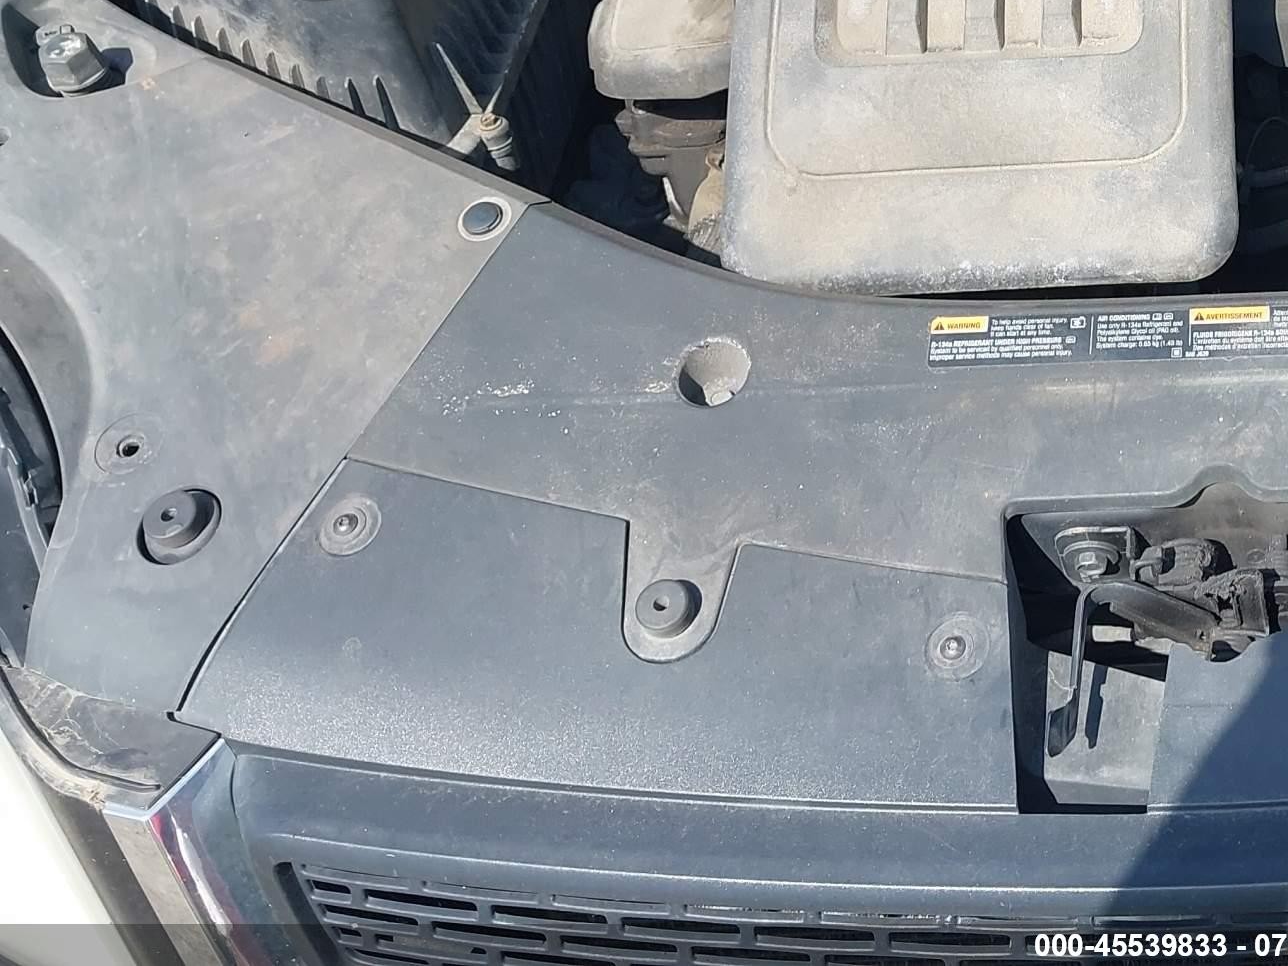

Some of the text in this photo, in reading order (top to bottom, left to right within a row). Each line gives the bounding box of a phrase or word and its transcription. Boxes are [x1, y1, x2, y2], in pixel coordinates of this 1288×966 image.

[1206, 312, 1263, 320] AVERTISSEMENT
[1027, 317, 1051, 325] personal
[947, 322, 981, 330] WARNING
